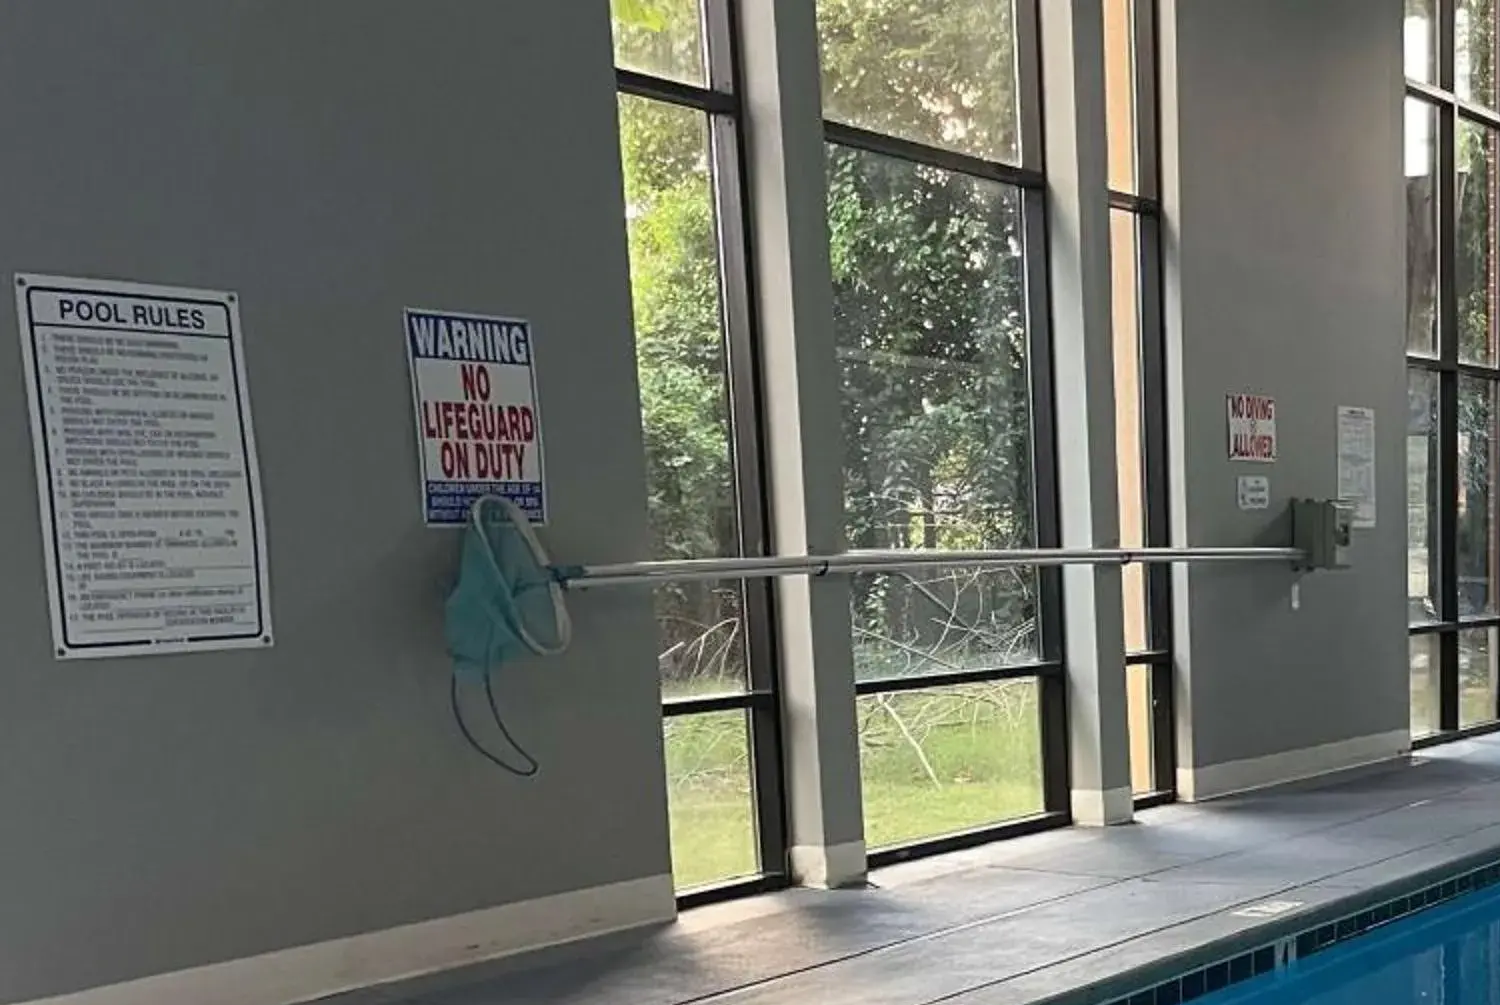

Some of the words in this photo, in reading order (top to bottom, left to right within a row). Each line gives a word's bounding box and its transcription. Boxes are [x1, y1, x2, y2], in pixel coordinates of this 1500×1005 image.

[59, 299, 127, 323] POOL
[133, 305, 205, 329] RULES
[411, 316, 528, 362] WARNING
[461, 364, 490, 401] NO
[423, 402, 534, 442] LIFEGUARD
[1232, 395, 1244, 419] NO
[1246, 396, 1272, 421] DIVING
[441, 441, 470, 478] ON
[475, 443, 524, 480] DUTY
